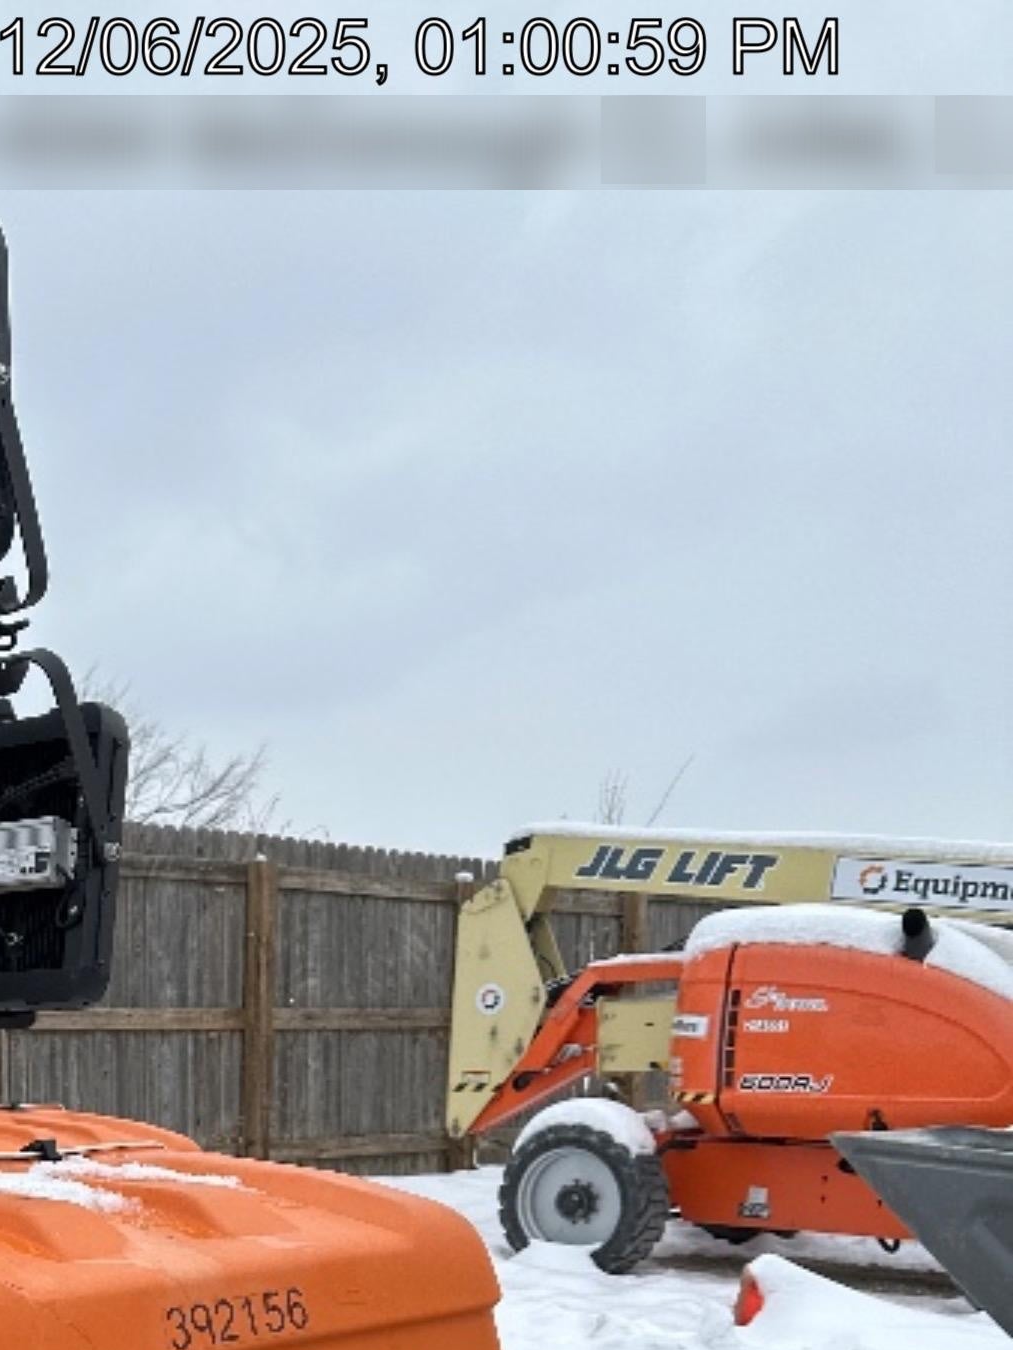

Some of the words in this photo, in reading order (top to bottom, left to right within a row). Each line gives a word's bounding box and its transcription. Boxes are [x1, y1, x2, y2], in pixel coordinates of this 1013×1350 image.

[574, 844, 667, 881] JLG
[665, 850, 780, 889] LIFT
[893, 869, 1013, 903] Equipm
[166, 1287, 309, 1350] 392156
